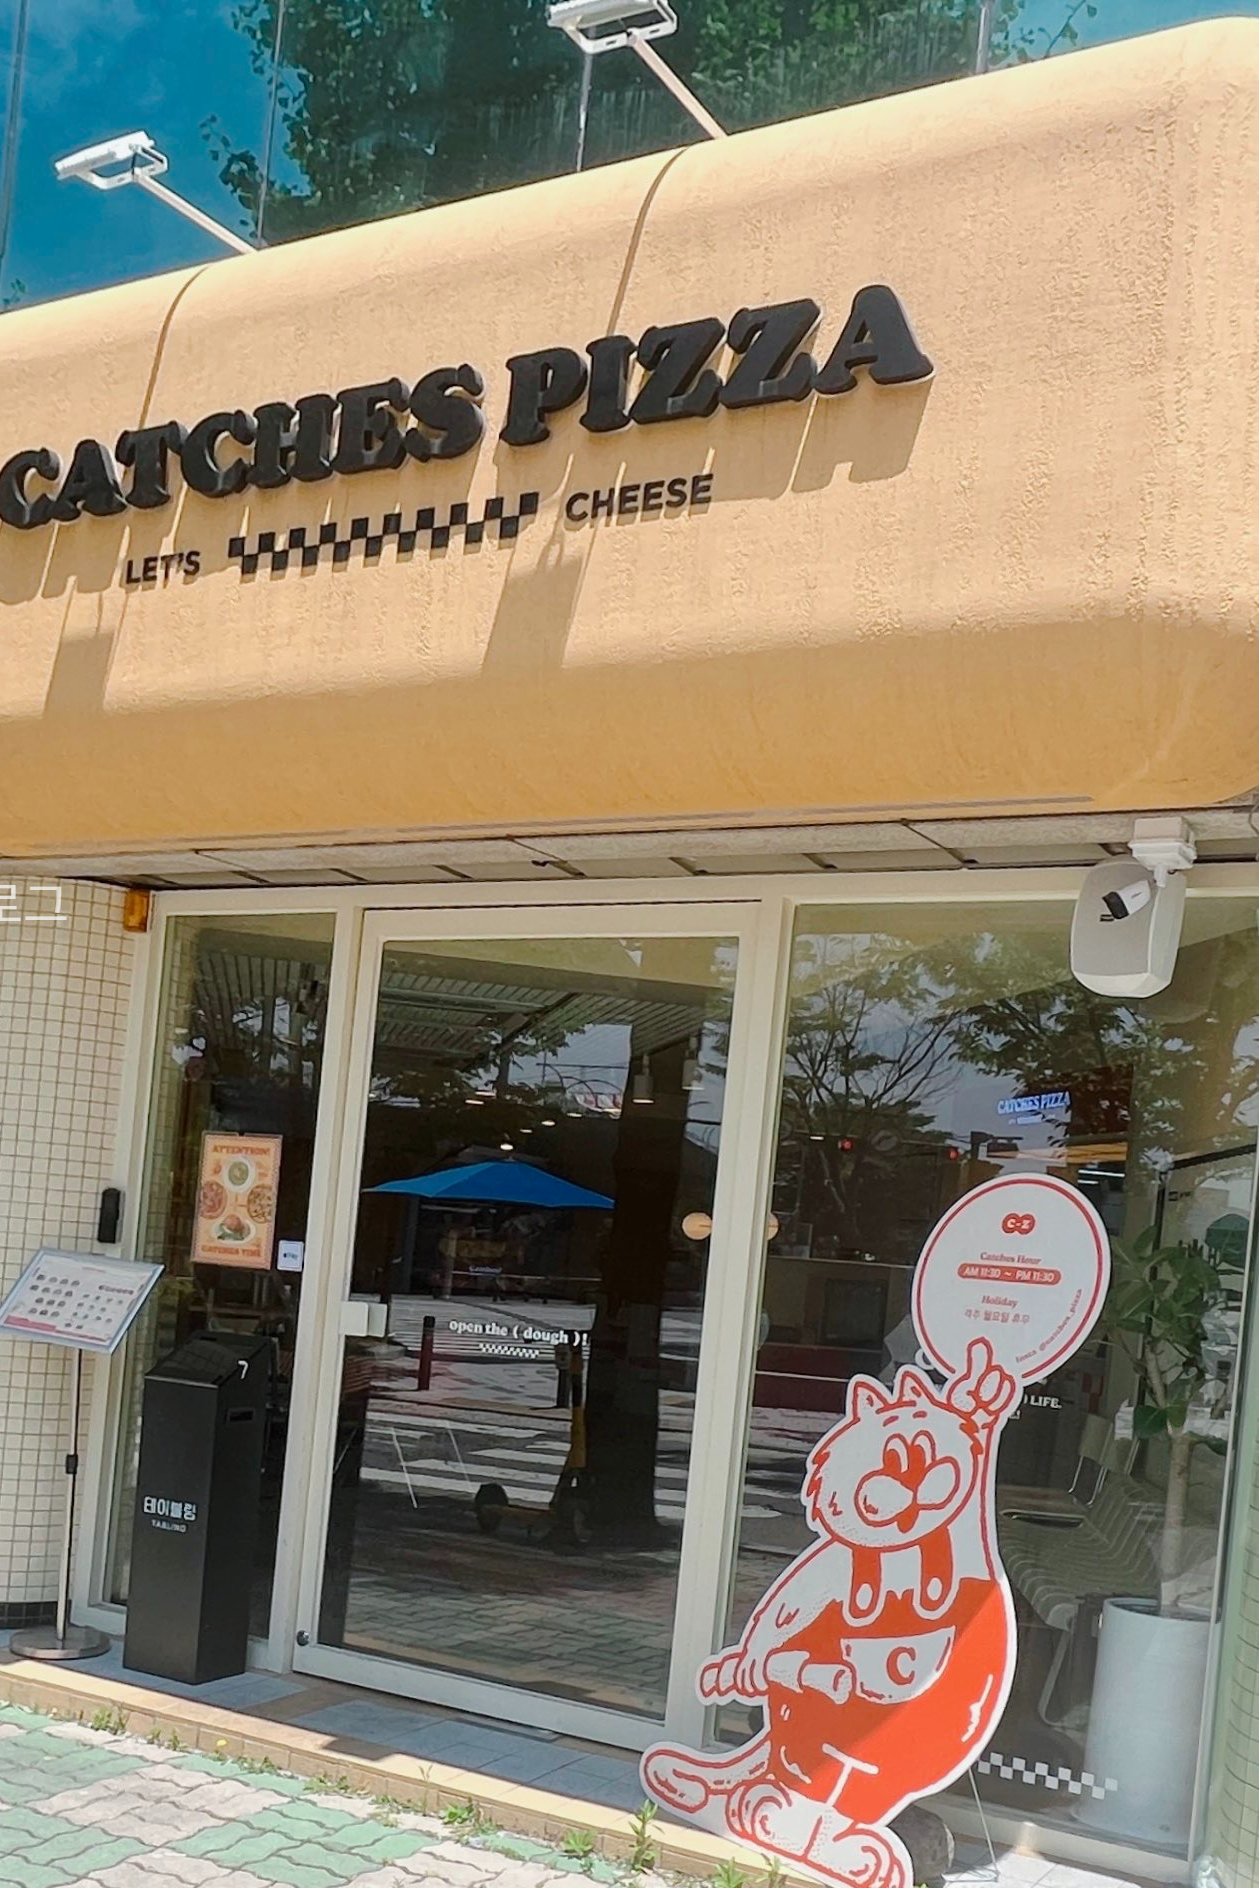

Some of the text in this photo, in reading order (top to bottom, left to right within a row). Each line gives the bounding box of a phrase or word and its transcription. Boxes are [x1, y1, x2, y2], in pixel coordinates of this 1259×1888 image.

[496, 283, 935, 447] PIZZA
[564, 473, 714, 523] CHEESE
[125, 549, 201, 586] LET'S
[981, 1296, 1018, 1308] Holiday
[449, 1319, 483, 1334] open
[485, 1322, 508, 1336] the
[523, 1326, 569, 1344] dough
[1030, 1395, 1062, 1409] LIFE.
[144, 1496, 196, 1520] 테이블링
[886, 1646, 916, 1686] C
